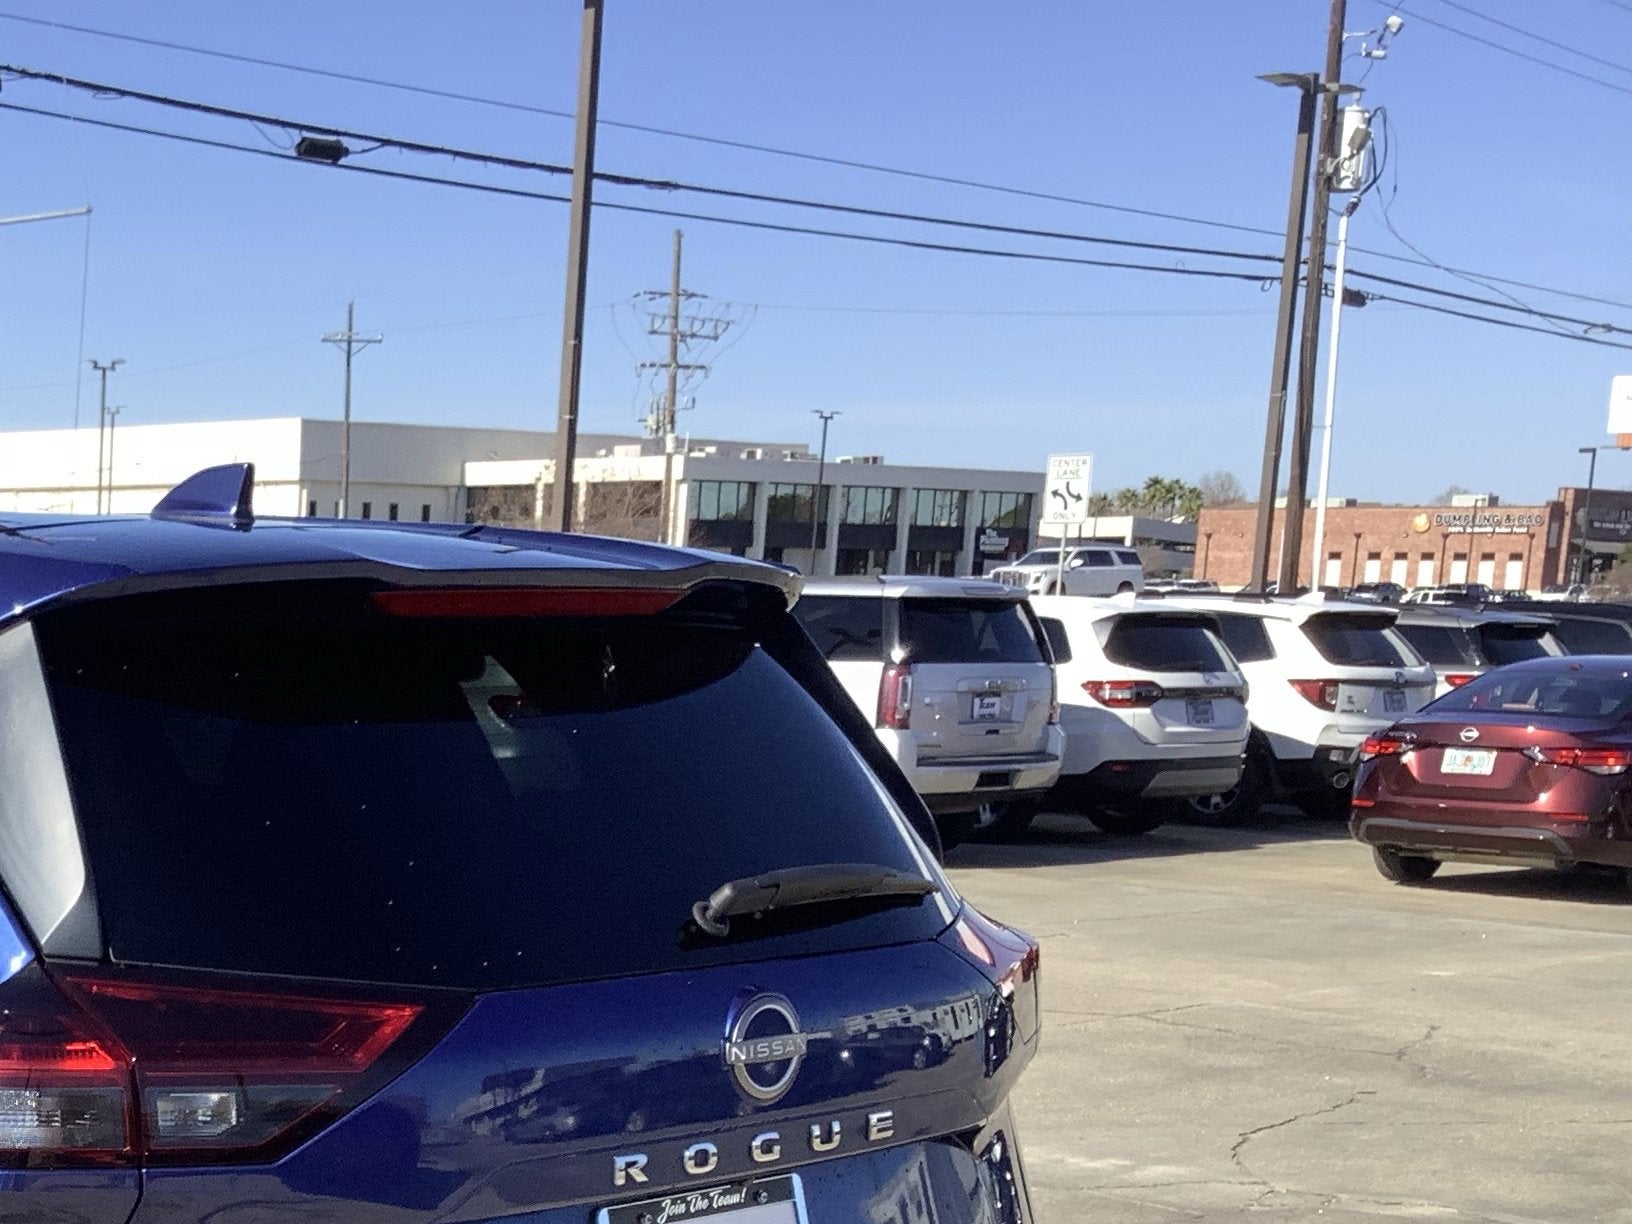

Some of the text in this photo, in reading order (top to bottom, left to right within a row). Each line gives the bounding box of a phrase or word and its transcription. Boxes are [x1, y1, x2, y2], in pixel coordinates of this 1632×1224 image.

[1052, 458, 1088, 467] CENTER
[1056, 468, 1081, 477] LANE
[1052, 511, 1077, 520] ONLY
[1504, 514, 1515, 526] &
[1517, 513, 1545, 526] BAO
[730, 1037, 807, 1061] NISSAN
[613, 1109, 895, 1187] ROGUE
[657, 1187, 747, 1224] Join The Team!
